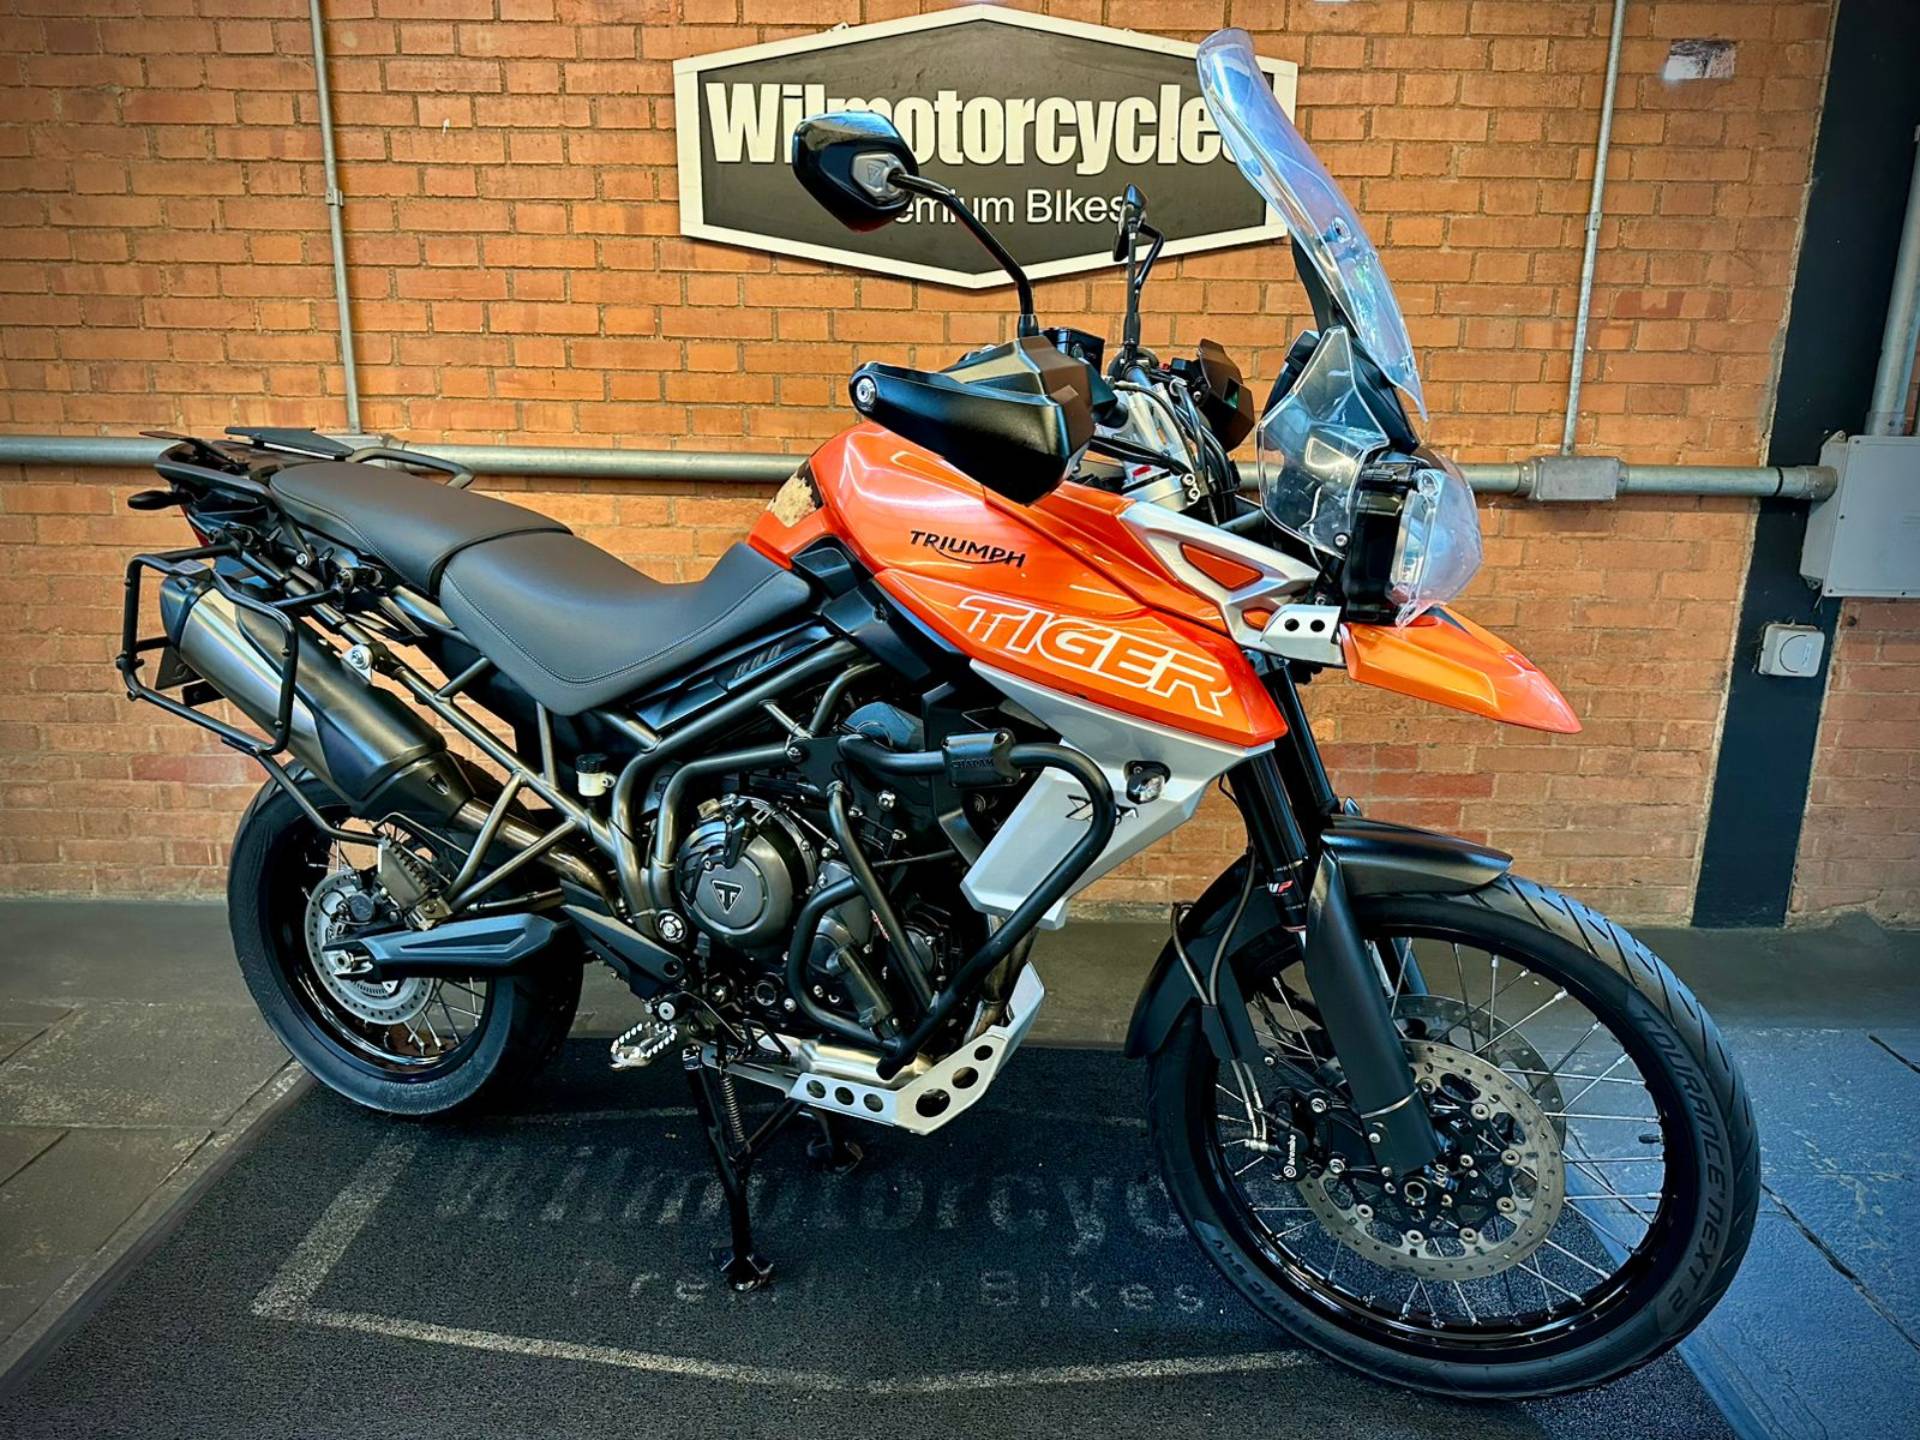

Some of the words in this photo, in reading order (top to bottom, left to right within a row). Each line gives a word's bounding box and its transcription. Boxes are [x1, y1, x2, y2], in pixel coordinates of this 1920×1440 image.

[911, 530, 1026, 568] TRIUMPH
[959, 595, 1233, 718] TIGER
[1635, 1009, 1725, 1190] TOURANCE
[1686, 1198, 1724, 1291] NEXT
[1668, 1286, 1690, 1314] 2
